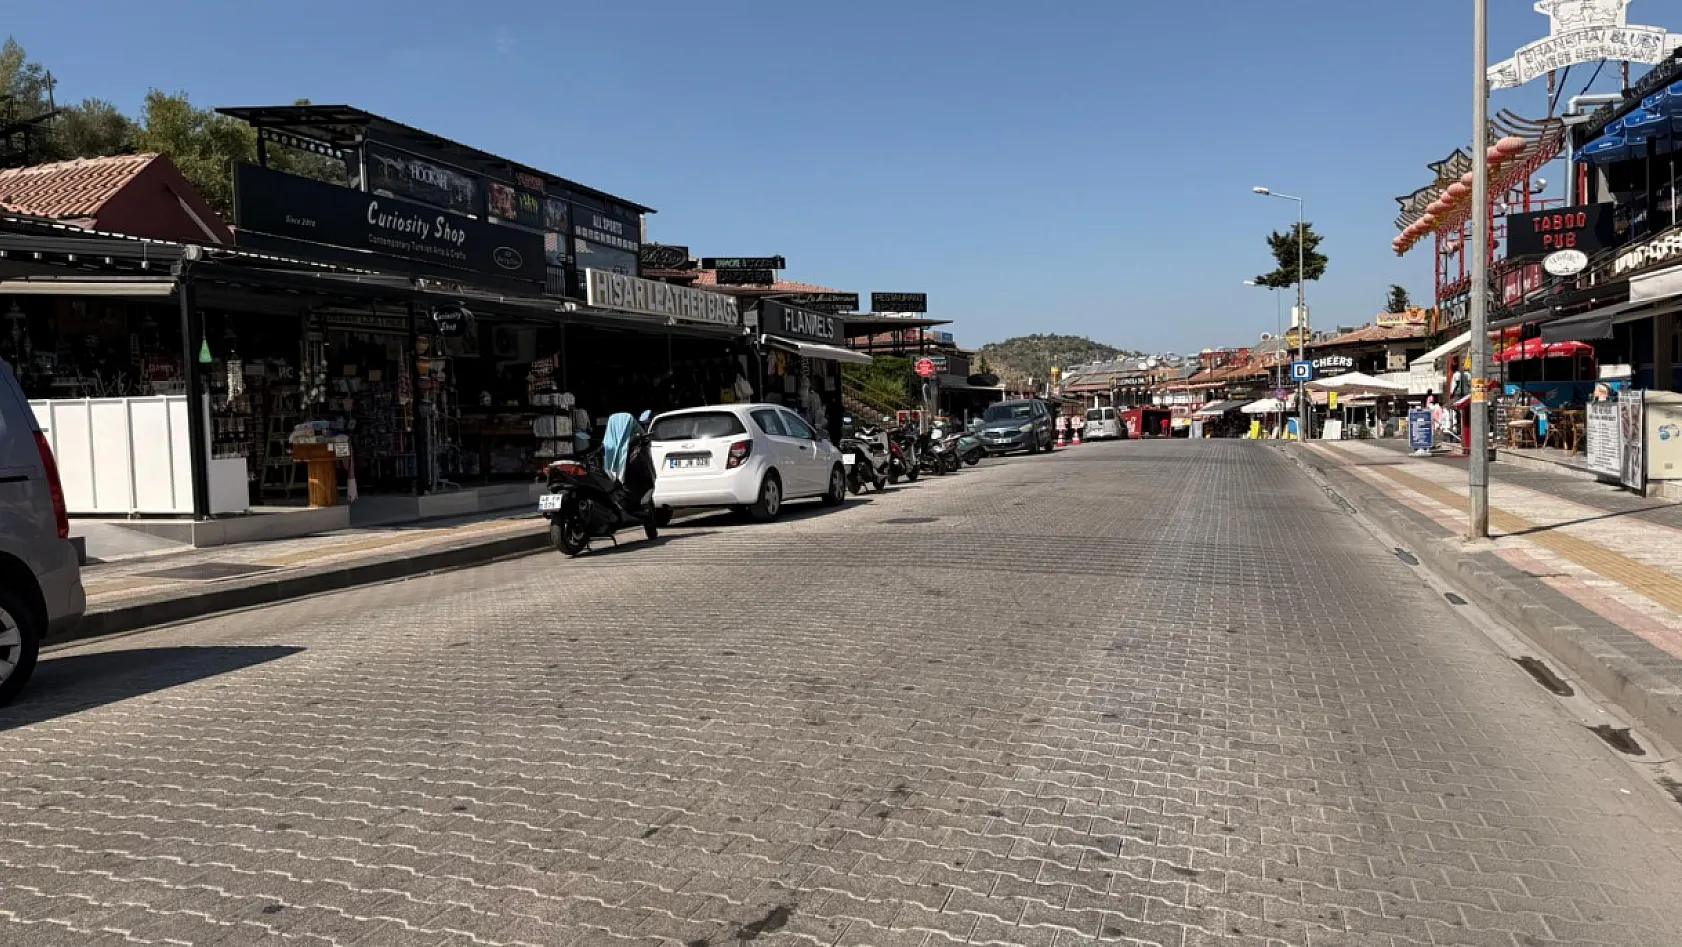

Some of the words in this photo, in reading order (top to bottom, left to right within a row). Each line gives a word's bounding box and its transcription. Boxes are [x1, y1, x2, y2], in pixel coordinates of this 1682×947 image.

[366, 200, 430, 239] Curiosity
[434, 216, 466, 245] Shop
[1533, 211, 1587, 233] TABOO
[1543, 231, 1577, 249] PUB
[595, 270, 643, 310] HISAR
[646, 282, 707, 320] LEATHER
[708, 293, 740, 325] BAGS
[1296, 365, 1306, 377] D
[1312, 355, 1353, 368] CHEERS
